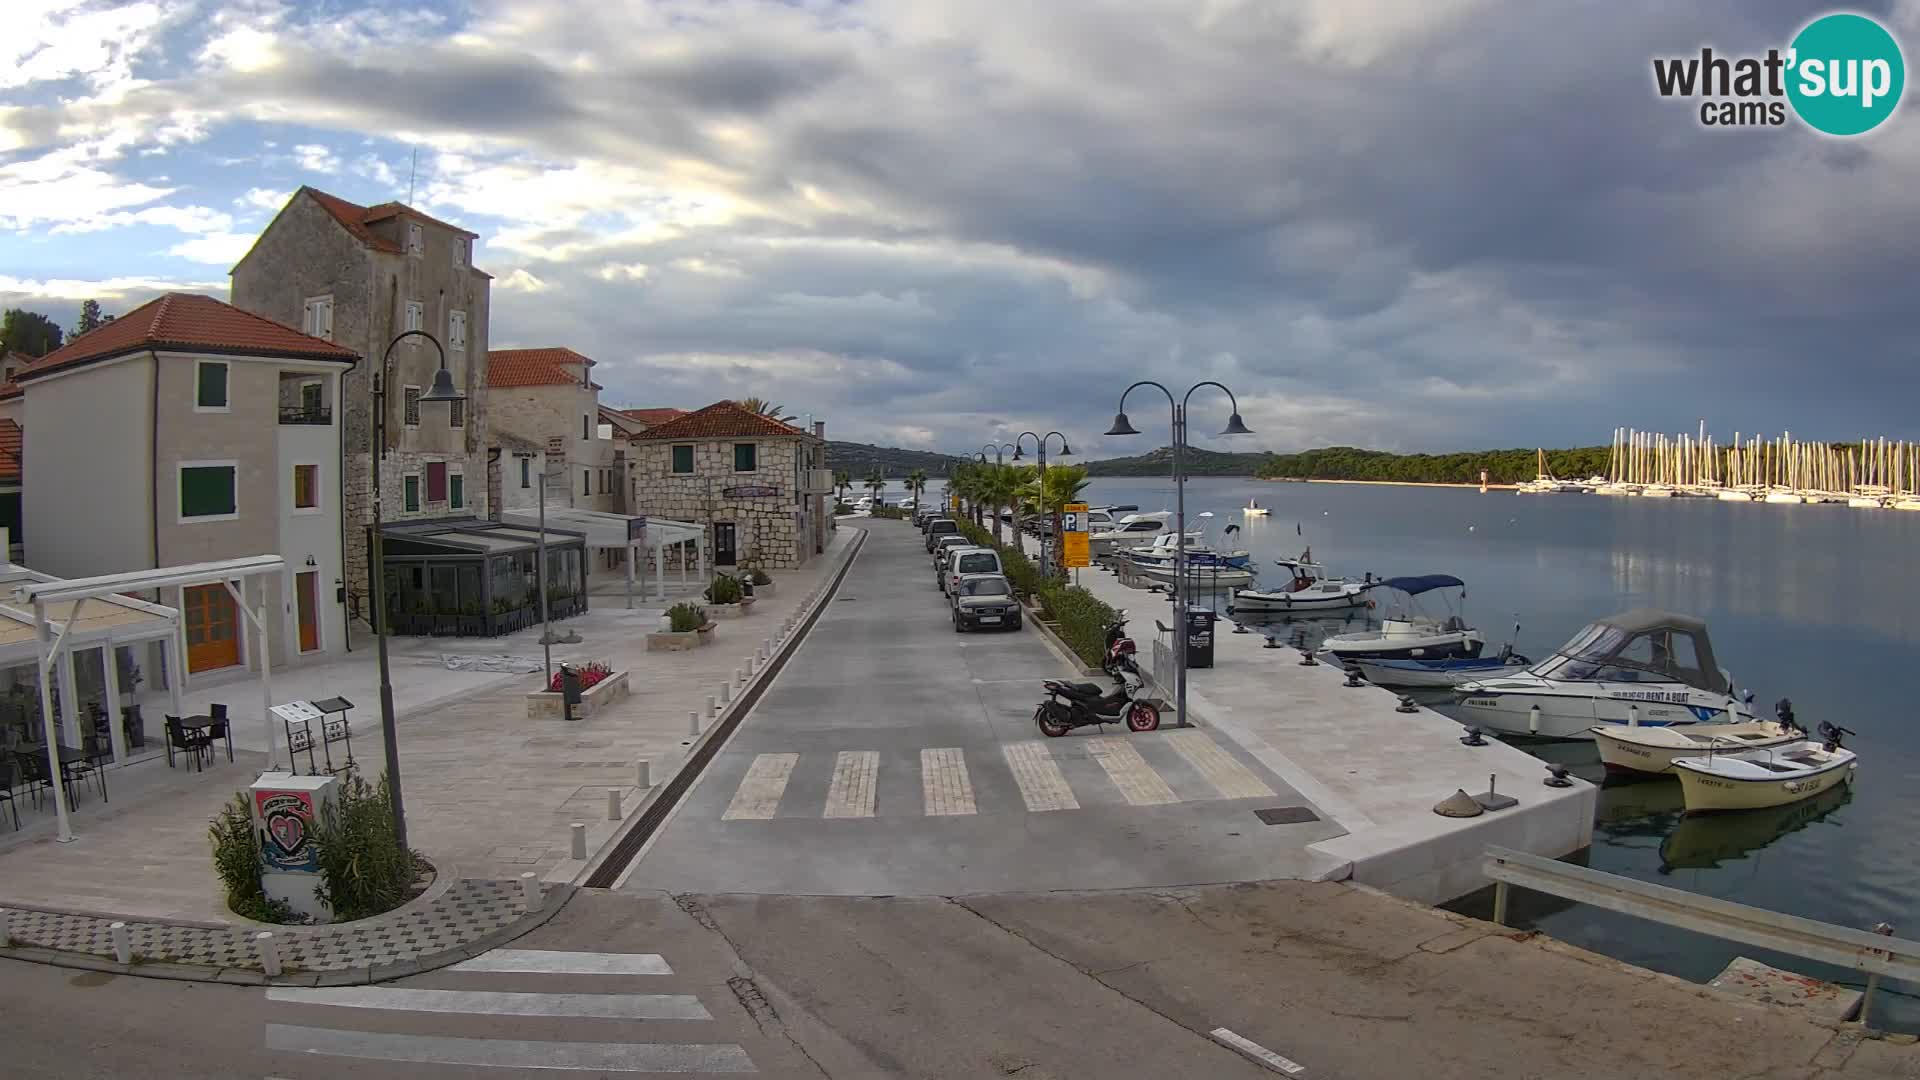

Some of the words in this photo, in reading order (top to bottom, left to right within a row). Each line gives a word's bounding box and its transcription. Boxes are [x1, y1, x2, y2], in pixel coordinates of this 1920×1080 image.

[1065, 514, 1076, 530] P
[1646, 691, 1664, 701] RENT
[1666, 692, 1670, 701] A
[1672, 692, 1690, 704] BOAT
